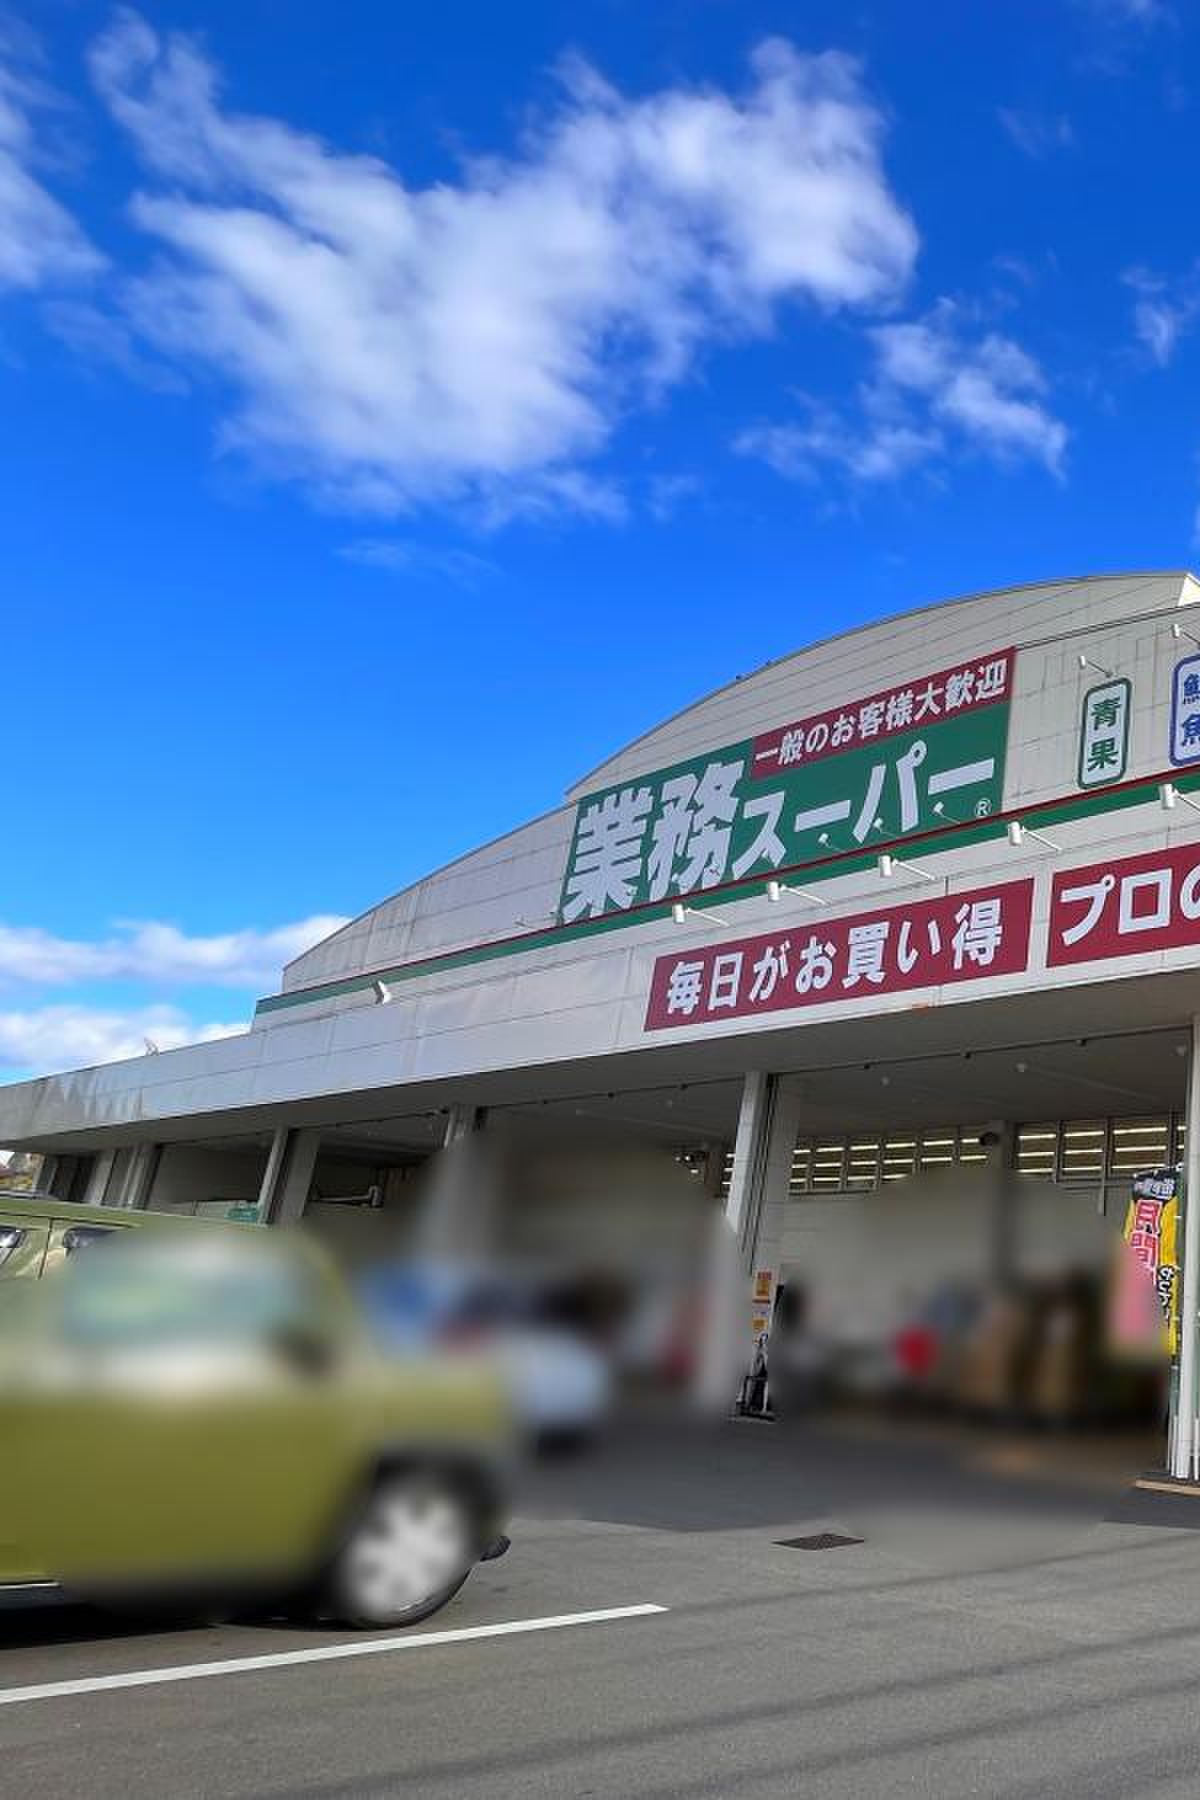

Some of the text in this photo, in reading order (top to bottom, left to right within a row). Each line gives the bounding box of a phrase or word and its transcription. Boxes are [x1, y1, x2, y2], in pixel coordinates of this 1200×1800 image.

[755, 658, 1008, 766] 一般のお客様大歓迎
[1086, 697, 1122, 775] 青果
[562, 738, 995, 924] 業務スーパー
[665, 897, 1003, 1016] 毎日がお買い得
